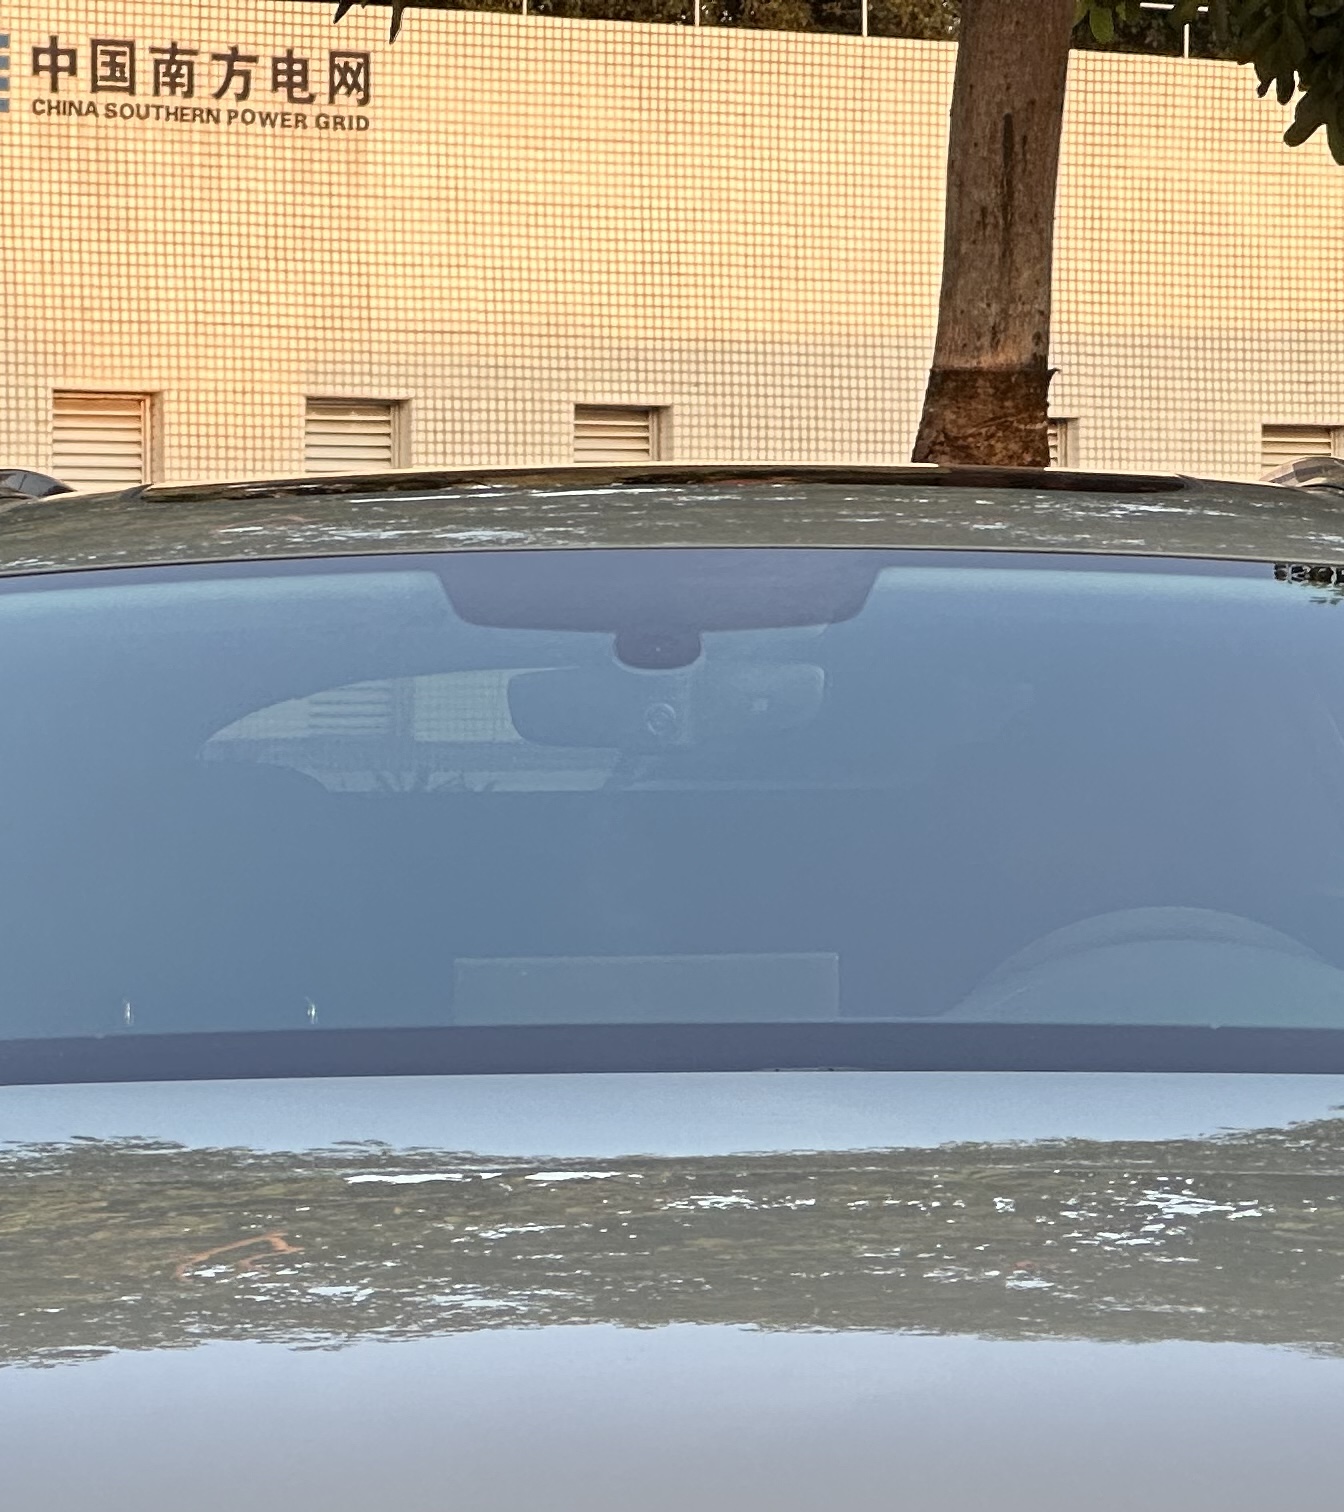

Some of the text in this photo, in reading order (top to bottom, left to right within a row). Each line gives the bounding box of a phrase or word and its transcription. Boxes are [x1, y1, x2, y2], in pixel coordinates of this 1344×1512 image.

[32, 35, 371, 107] 中国南方电网
[32, 98, 371, 132] CHINA SOUTHERN POWER GRID
